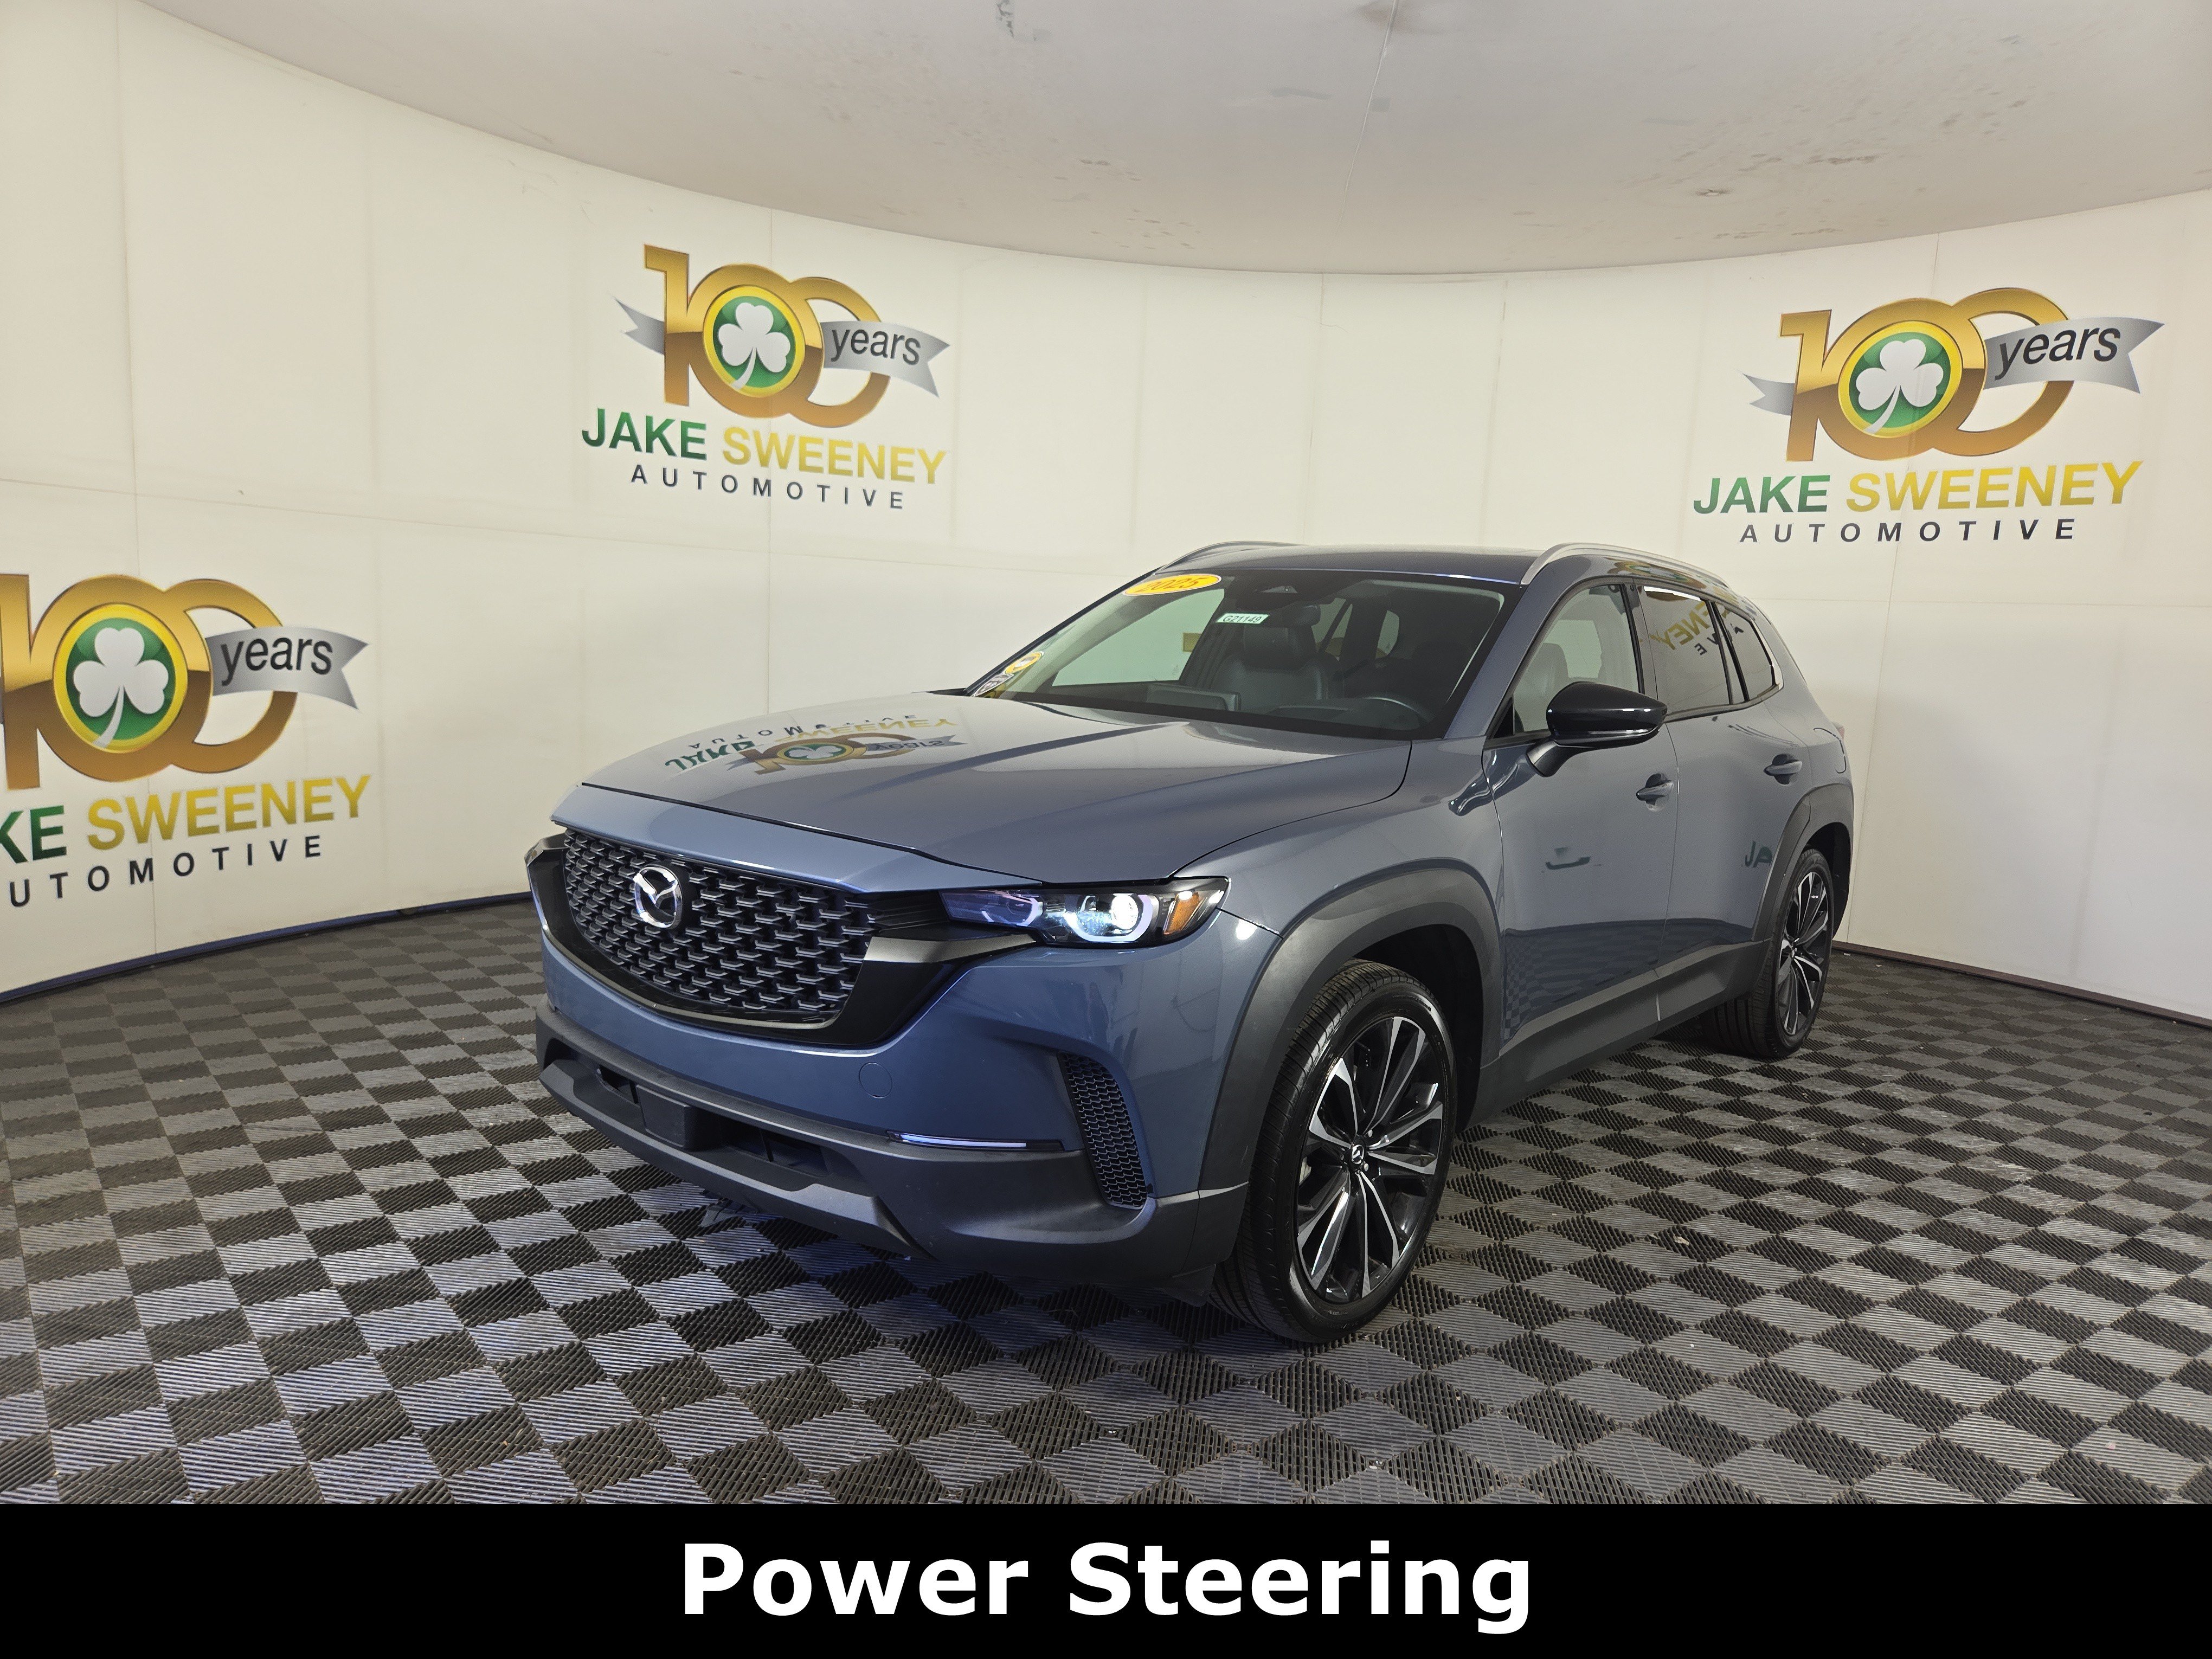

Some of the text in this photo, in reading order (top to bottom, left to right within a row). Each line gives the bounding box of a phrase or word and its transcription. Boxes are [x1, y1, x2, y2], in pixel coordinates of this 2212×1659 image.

[644, 244, 921, 428] 100 years
[1779, 287, 2121, 462] 100 years
[582, 408, 947, 485] JAKE SWEENEY
[631, 464, 904, 510] AUTOMOTIVE
[1693, 460, 2143, 515] JAKE SWEENEY
[1740, 518, 2076, 544] AUTOMOTIVE
[1135, 577, 1210, 593] 2025
[1223, 615, 1262, 623] G21149
[220, 636, 333, 686] years
[0, 775, 372, 864] KE SWEENEY
[9, 835, 321, 908] UTOMOTIVE
